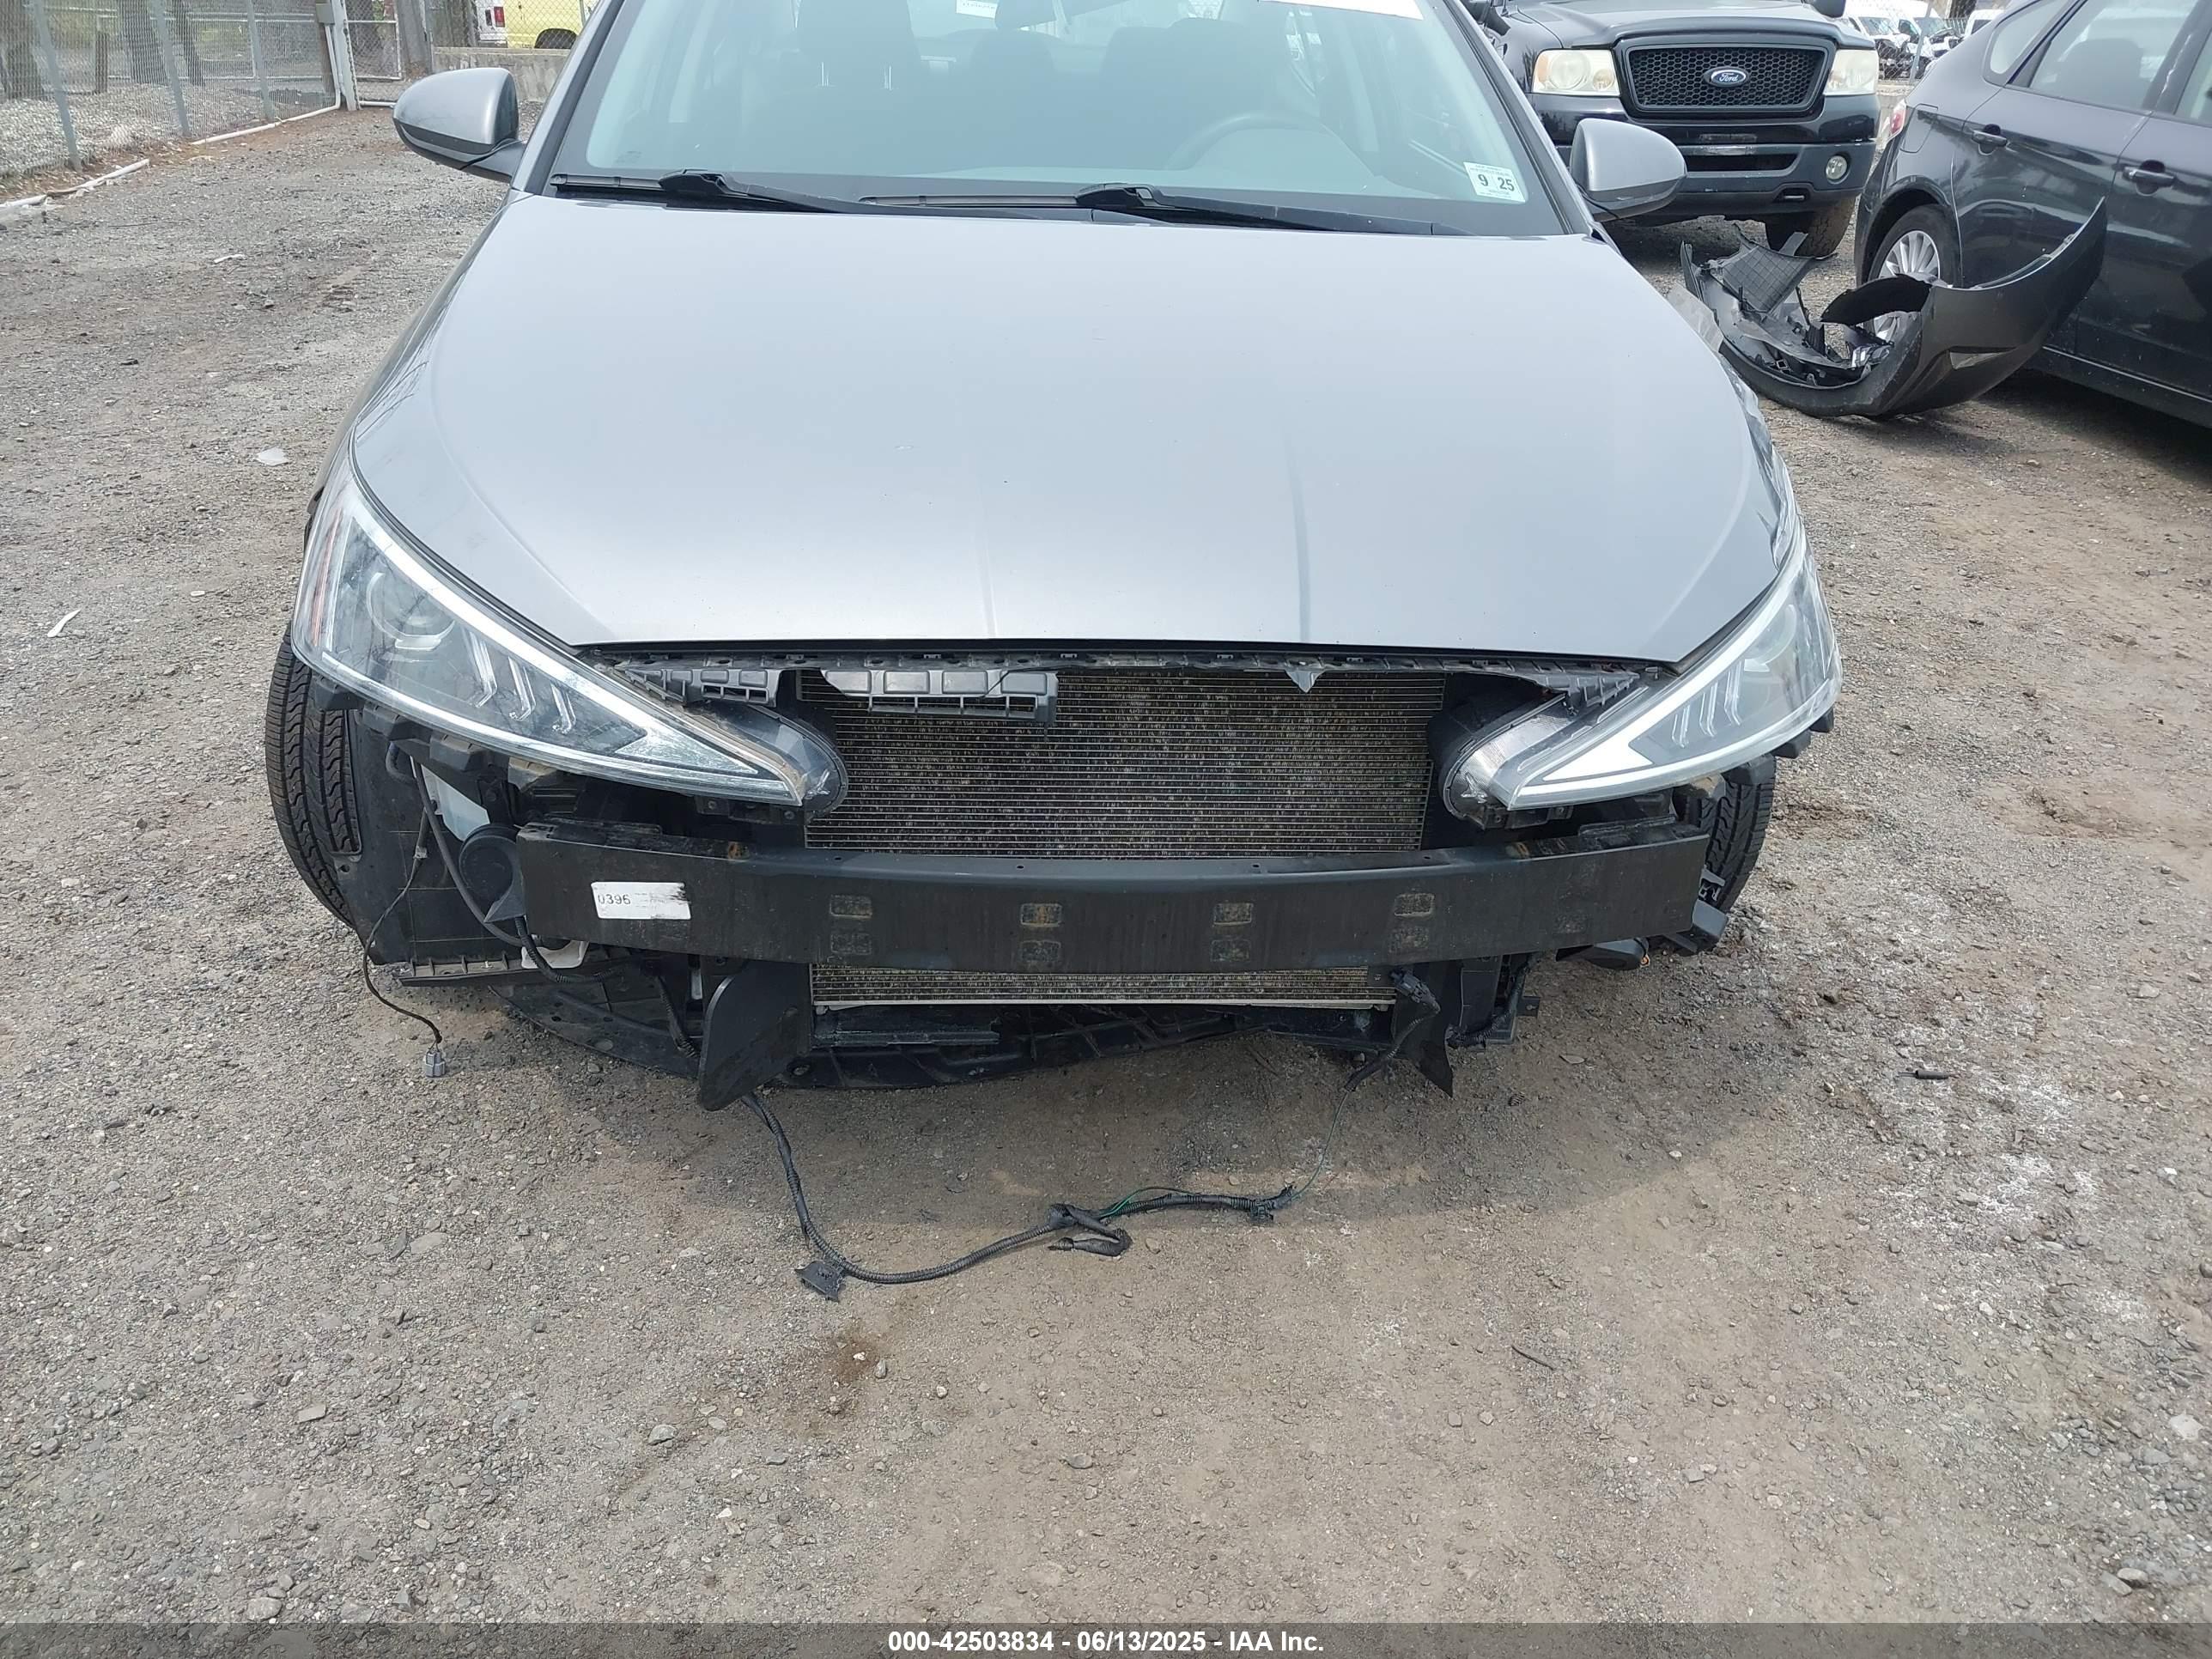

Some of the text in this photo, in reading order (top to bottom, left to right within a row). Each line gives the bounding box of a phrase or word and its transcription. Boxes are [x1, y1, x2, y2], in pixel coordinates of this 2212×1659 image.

[1719, 73, 1739, 82] Ford
[1478, 173, 1515, 191] 9 25
